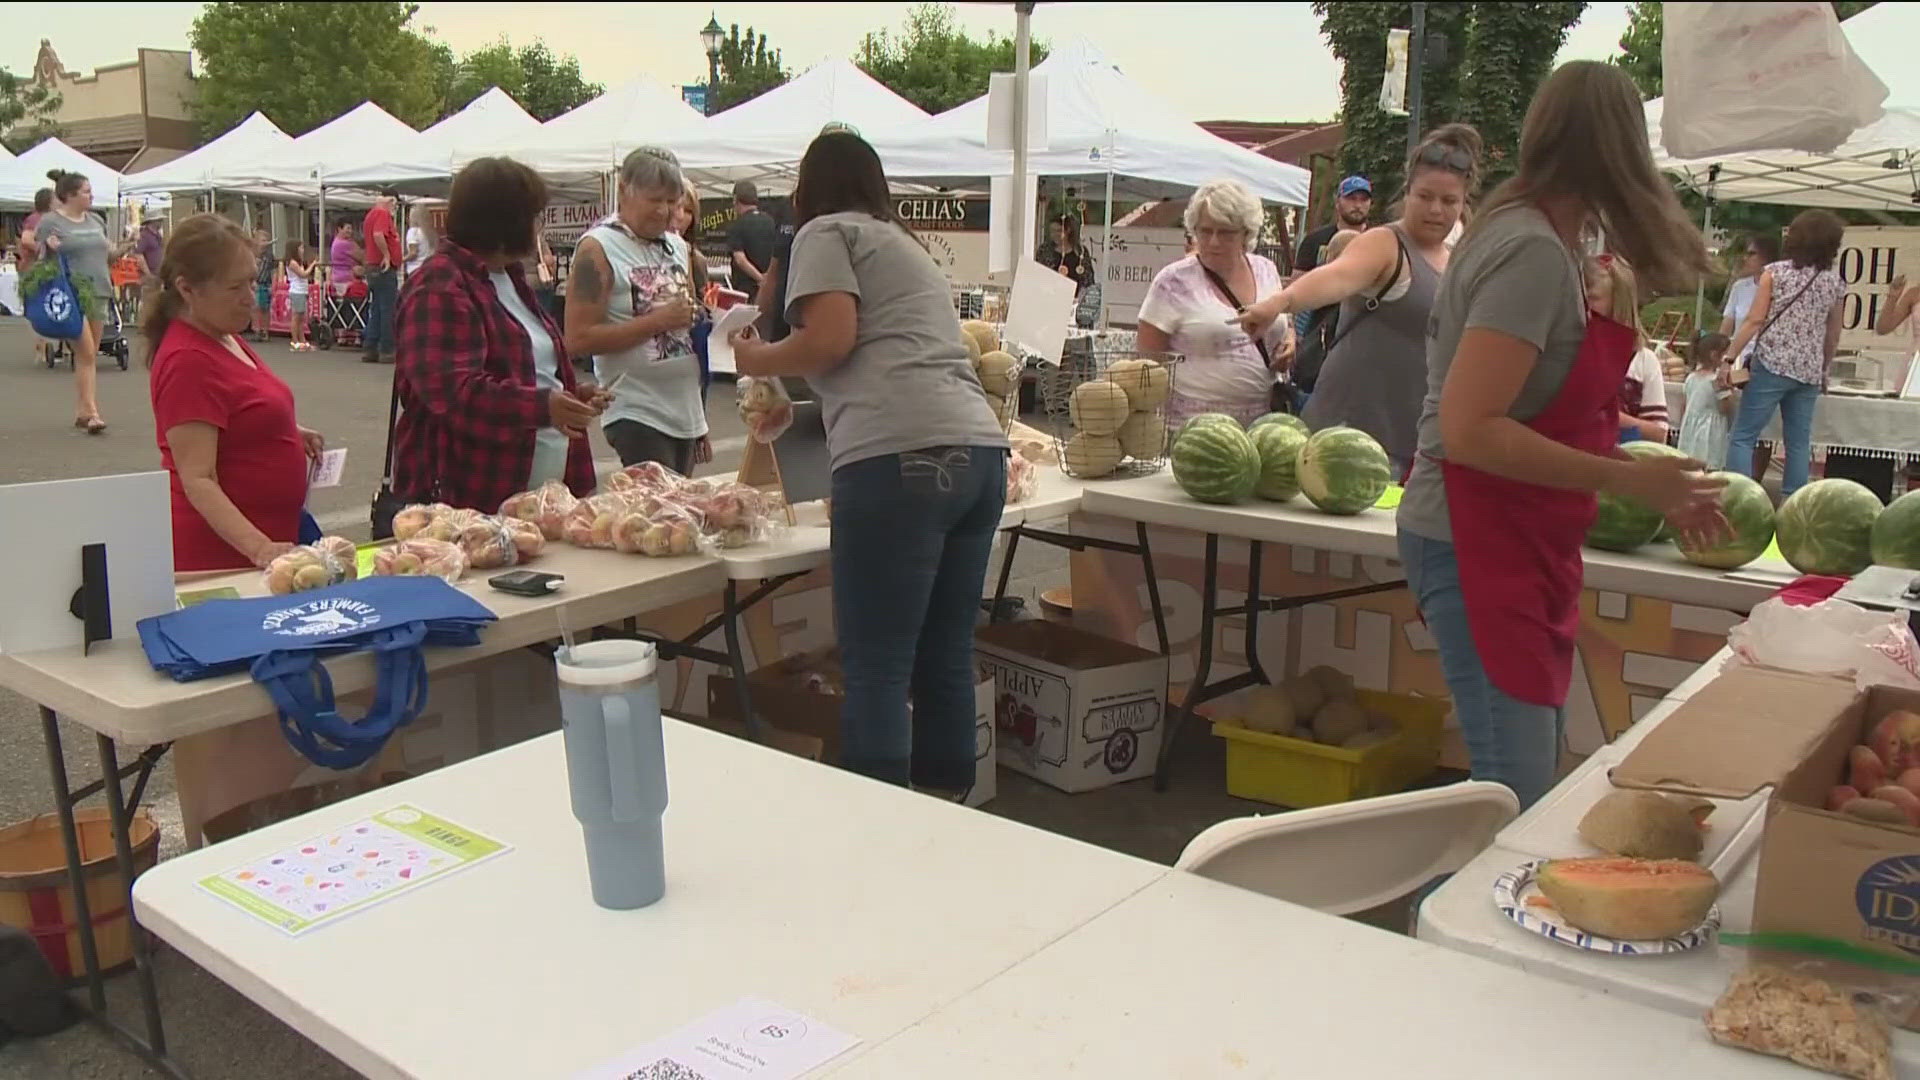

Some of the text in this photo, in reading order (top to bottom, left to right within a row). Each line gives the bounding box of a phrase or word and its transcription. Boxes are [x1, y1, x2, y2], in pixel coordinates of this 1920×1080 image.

[544, 207, 558, 223] HE
[898, 200, 966, 220] CELIA'S
[700, 211, 724, 231] High
[1108, 266, 1154, 282] 08 BELL
[308, 597, 377, 615] FARMERS
[1871, 887, 1920, 925] ID
[759, 1024, 790, 1039] BS
